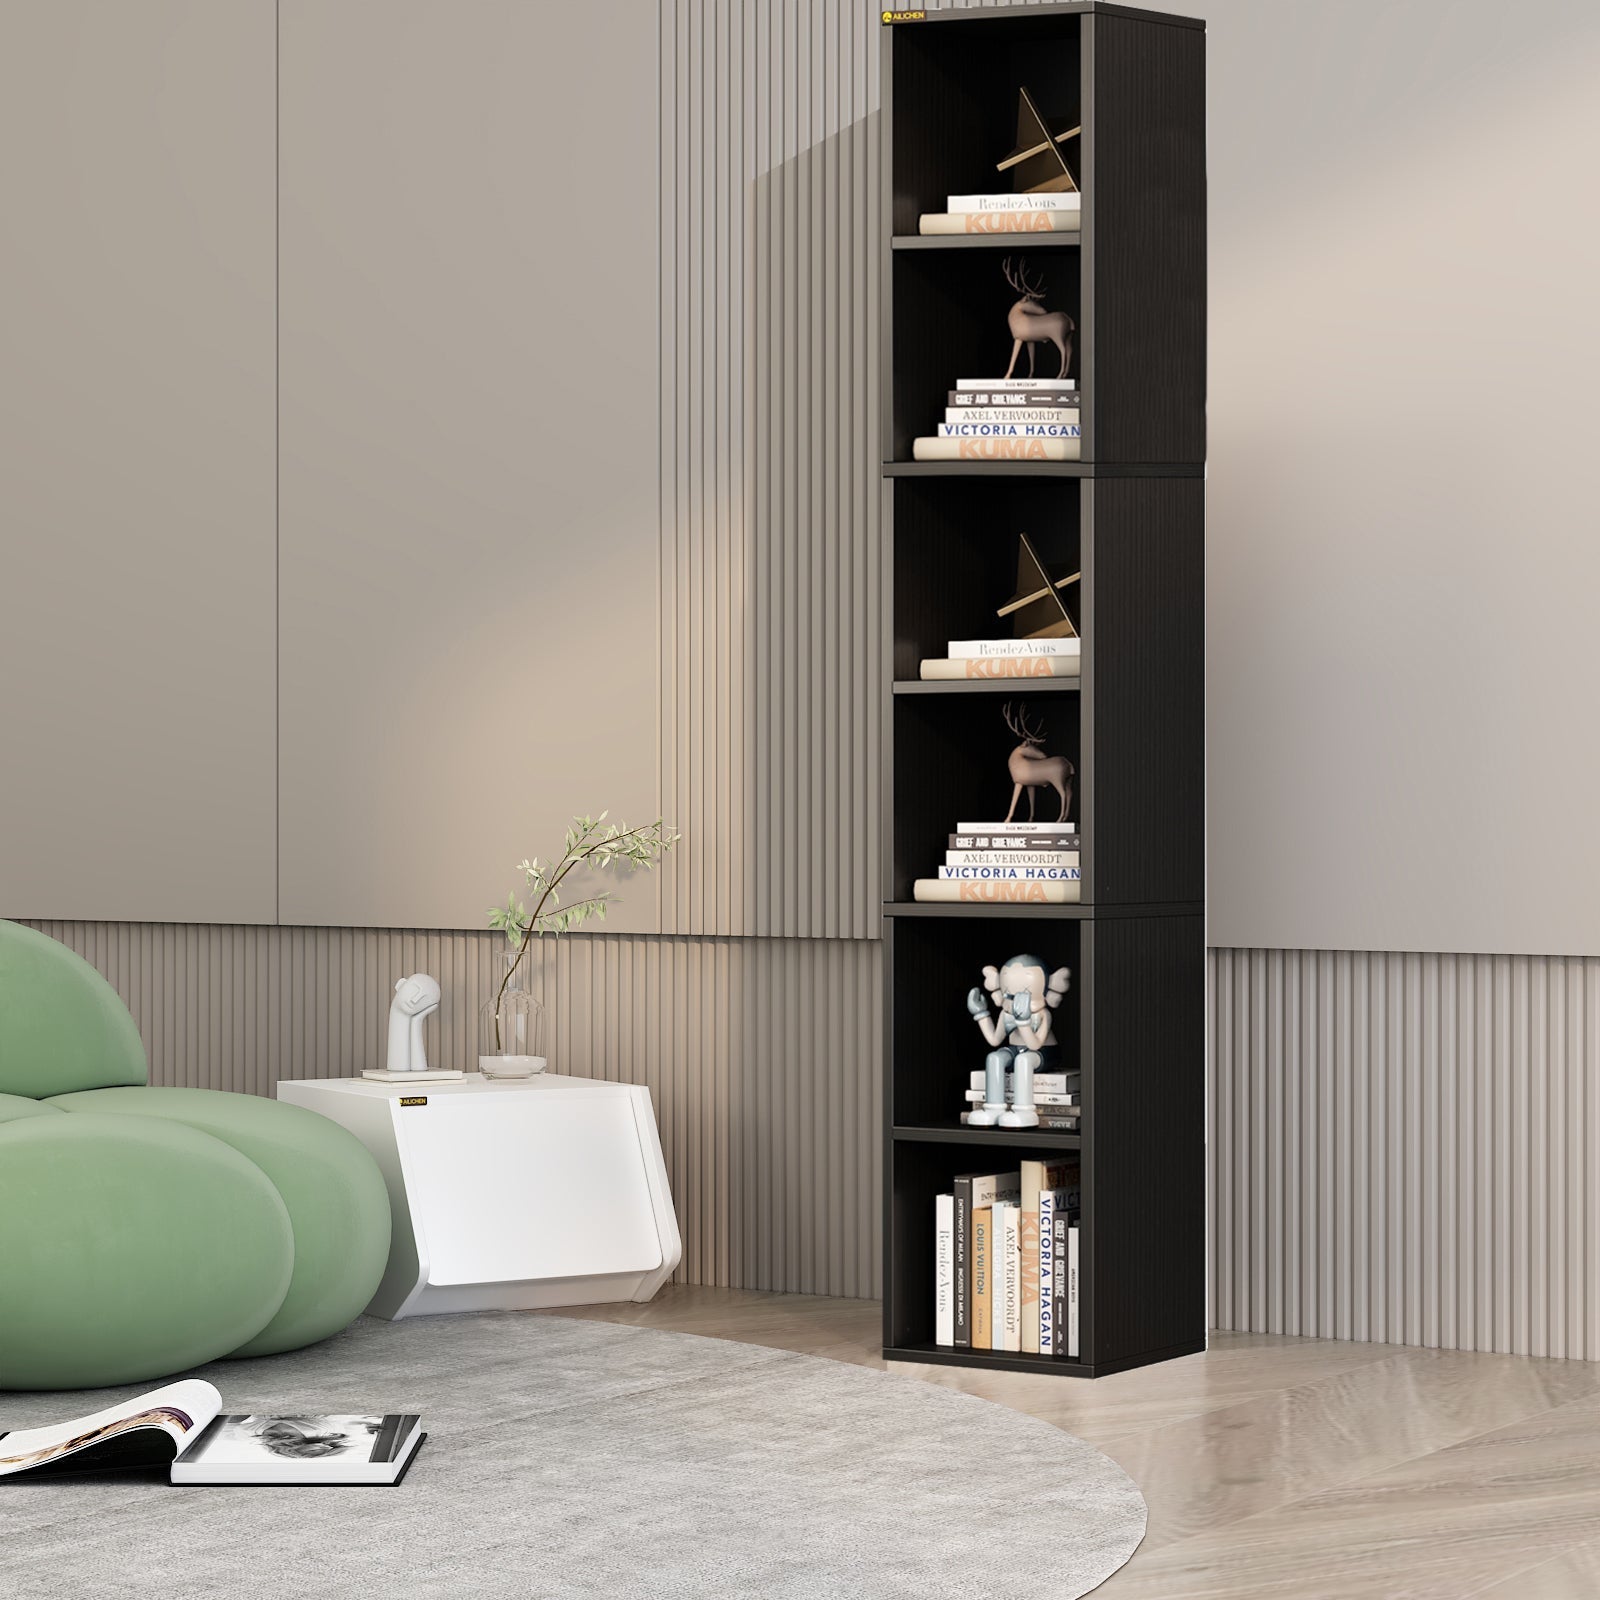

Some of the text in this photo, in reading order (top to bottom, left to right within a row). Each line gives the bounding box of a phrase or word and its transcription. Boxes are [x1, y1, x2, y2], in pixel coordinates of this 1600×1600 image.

[979, 197, 1057, 210] Rendez-Vous
[965, 212, 1054, 233] KUMA
[963, 411, 1062, 421] AXEL VERVOORDT
[945, 424, 1081, 436] VICTORIA HAGAN
[959, 439, 1048, 459] KUMA
[979, 643, 1057, 655] Rendez-Vous
[965, 658, 1054, 679] KUMA
[963, 854, 1062, 864] AXEL VERVOORDT
[945, 867, 1081, 878] VICTORIA HAGAN
[959, 882, 1048, 902] KUMA
[976, 1223, 985, 1295] LOUIS VUITTON
[1022, 1211, 1039, 1306] KUMA
[939, 1230, 950, 1312] Rendez-Vous
[1006, 1226, 1015, 1333] AXEL VERVOORDT
[1041, 1199, 1051, 1346] VICTORIA HAGAN
